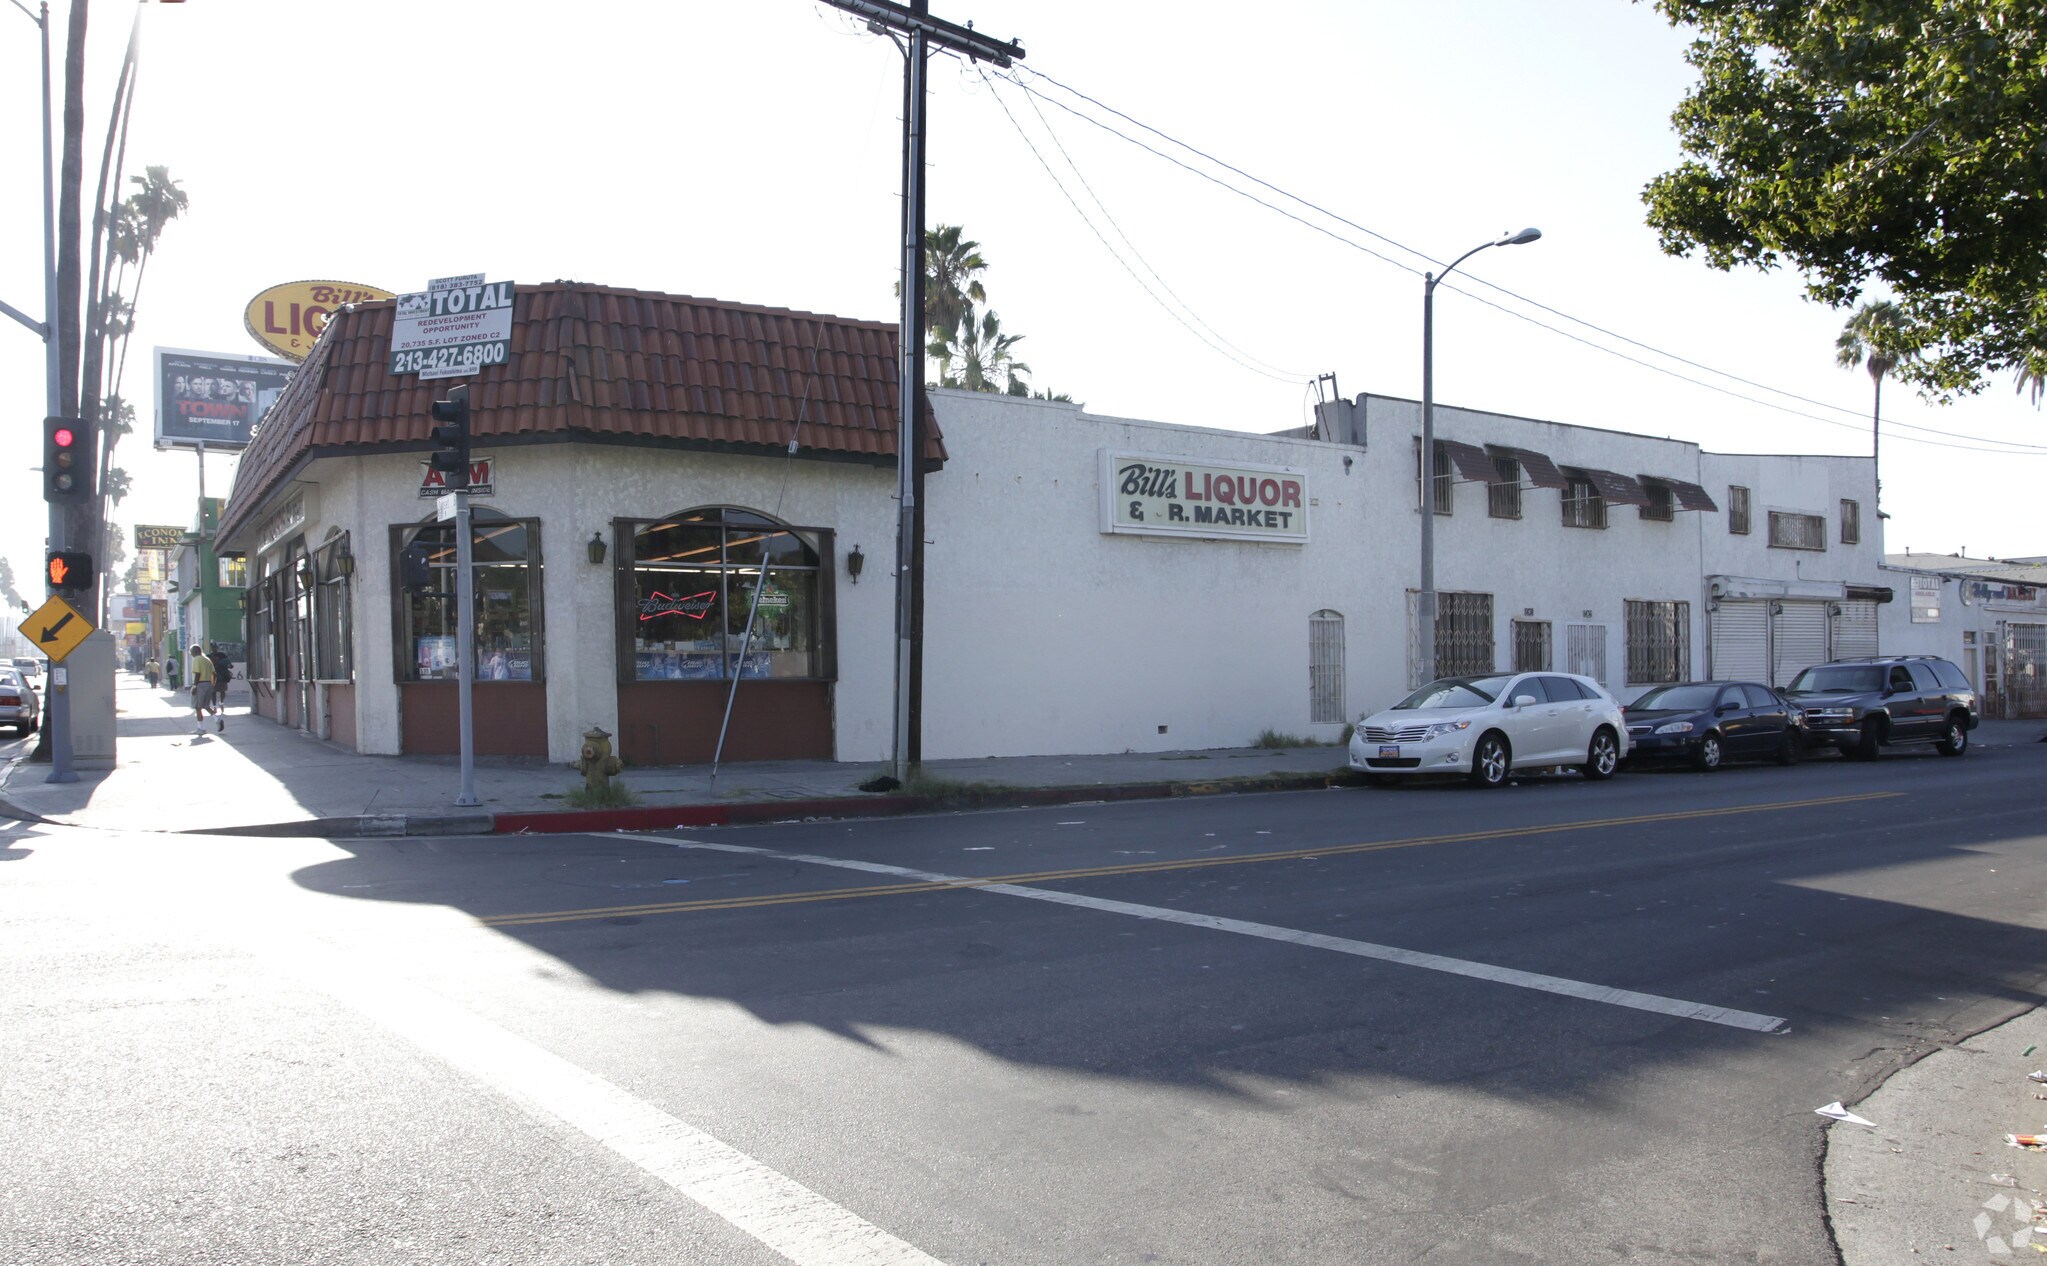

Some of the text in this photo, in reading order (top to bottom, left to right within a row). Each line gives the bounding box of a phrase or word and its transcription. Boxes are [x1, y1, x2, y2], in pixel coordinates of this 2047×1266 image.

[429, 279, 483, 291] (818) 383-7752
[435, 276, 454, 284] SCOTT
[433, 283, 512, 315] TOTAL
[264, 300, 329, 338] LIQ
[417, 312, 487, 327] REDEVELOPMENT
[423, 321, 481, 334] OPPORTUNITY
[291, 338, 301, 348] &
[401, 331, 501, 349] 20,735 S.F. LOT ZONED C2
[394, 342, 505, 373] 213-427-6800
[176, 399, 248, 418] TOWN
[188, 416, 231, 426] SEPTEMBER
[422, 462, 489, 486] AM
[1118, 463, 1301, 508] Bill's LIQUOR
[1129, 500, 1144, 522] &
[1194, 505, 1293, 529] MARKET
[138, 528, 184, 539] ECONOM
[1919, 577, 1940, 590] TOTAL
[638, 597, 715, 613] Budweiser
